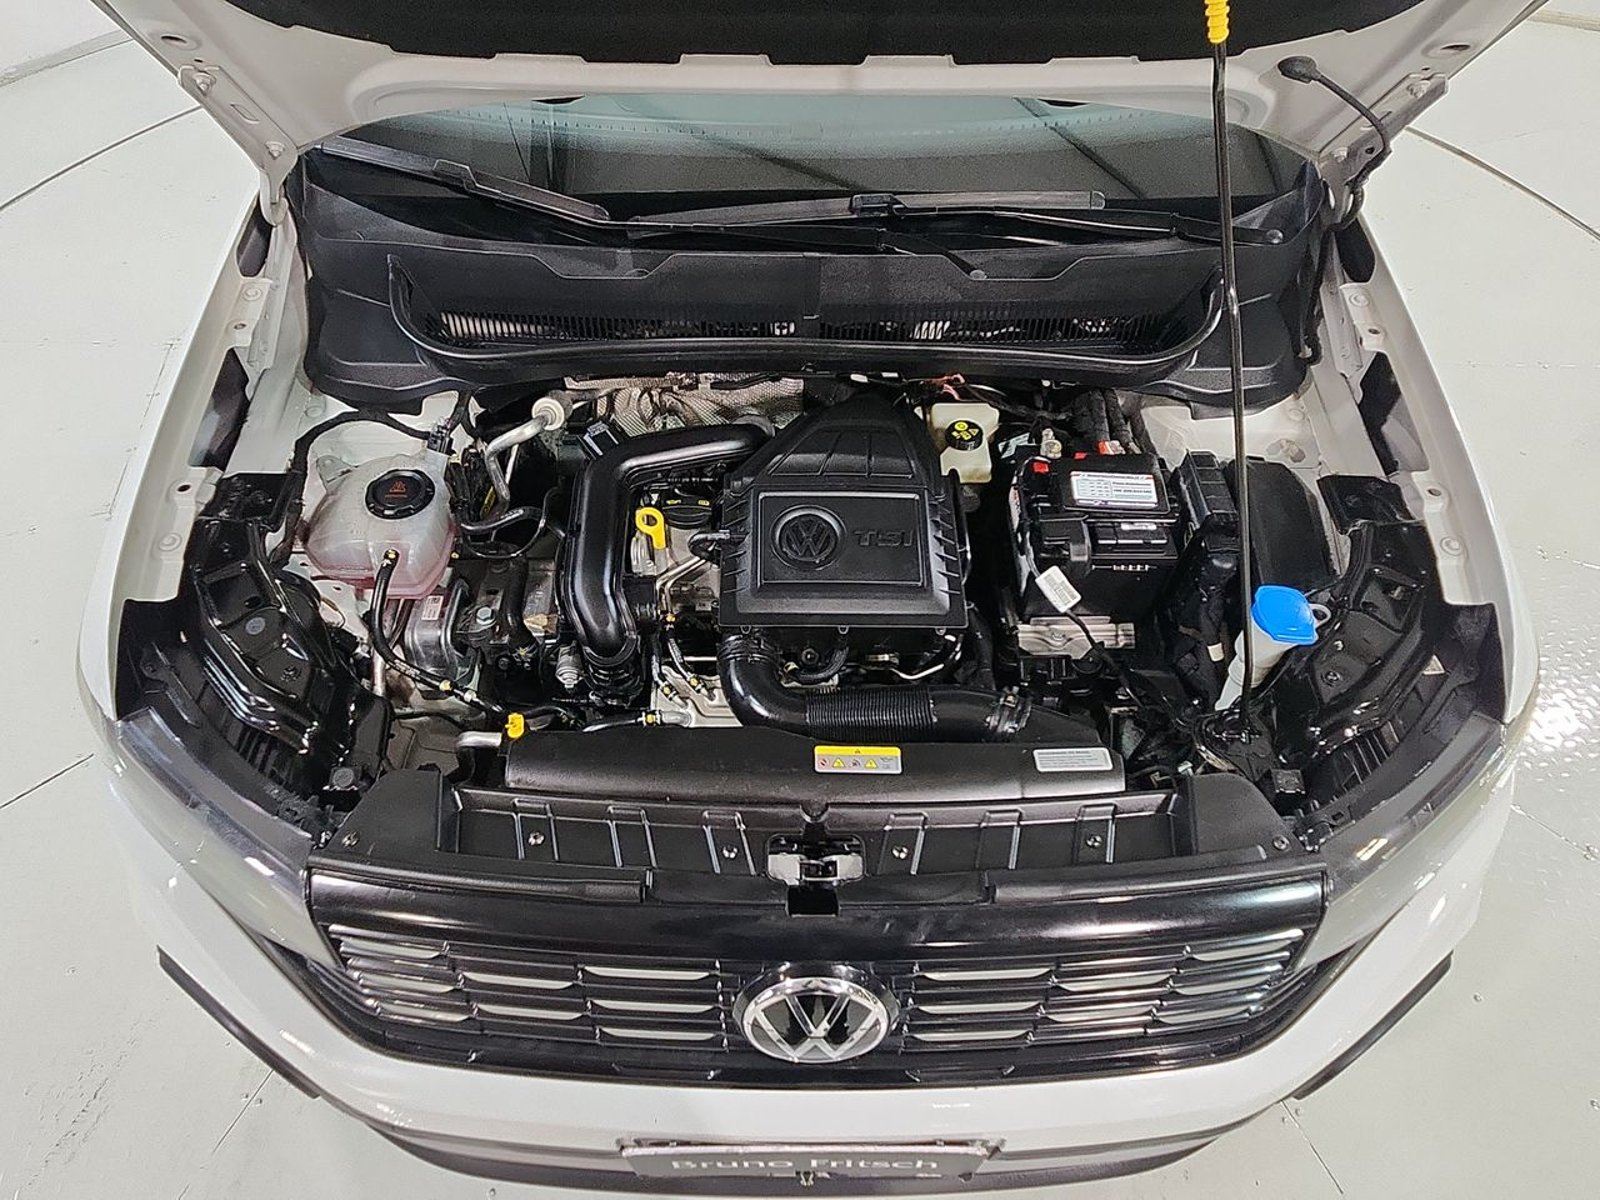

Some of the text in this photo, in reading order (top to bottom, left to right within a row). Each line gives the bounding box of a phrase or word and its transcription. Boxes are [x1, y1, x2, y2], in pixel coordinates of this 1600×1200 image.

[854, 528, 916, 547] TSI
[671, 1158, 938, 1170] Bruno Fritsch
